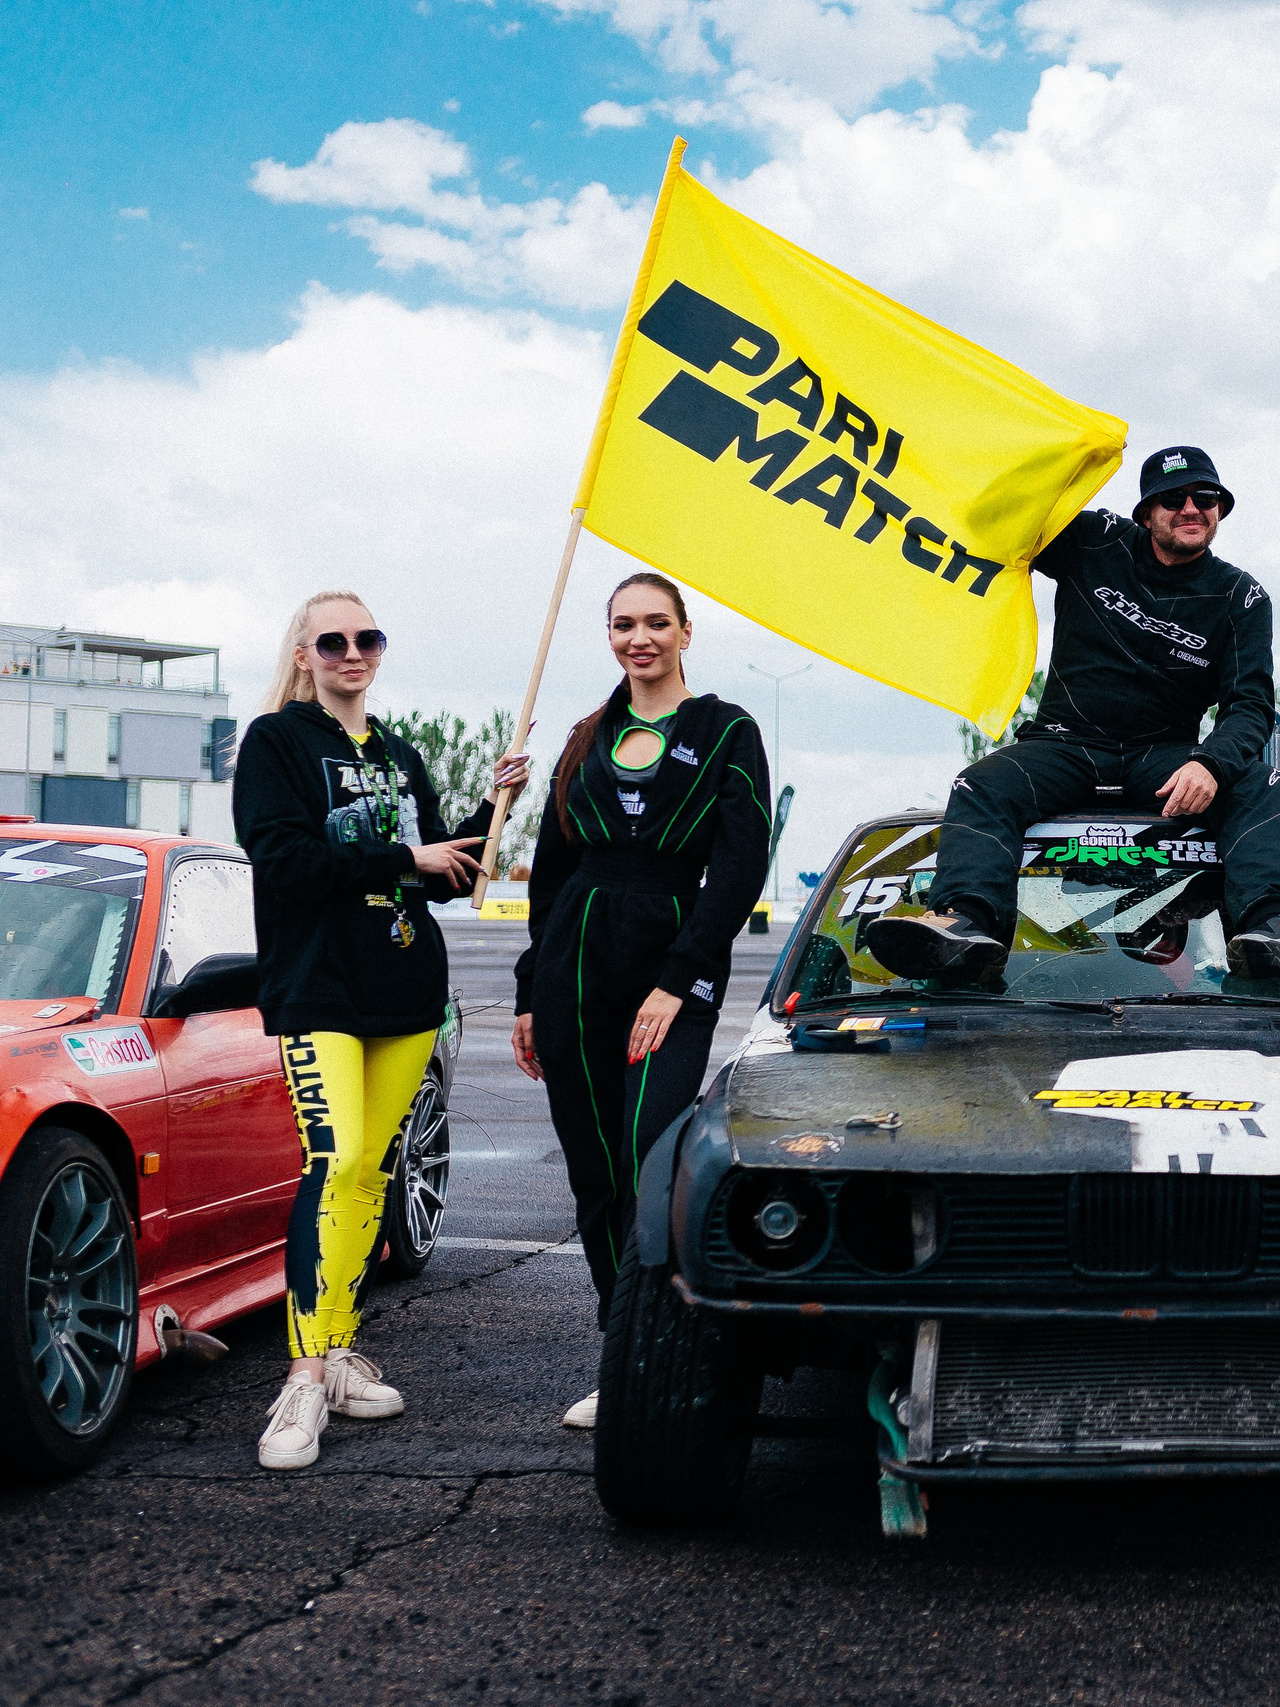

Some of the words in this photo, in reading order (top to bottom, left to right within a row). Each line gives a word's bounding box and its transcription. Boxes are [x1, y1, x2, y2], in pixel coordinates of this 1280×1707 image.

[637, 279, 905, 479] PARI
[1162, 458, 1188, 471] GORILLA
[639, 369, 1007, 598] MATCH
[670, 748, 698, 766] GORILLA
[1078, 836, 1136, 847] GORILLA
[1157, 839, 1217, 852] STRE
[837, 875, 910, 918] 15
[88, 1032, 150, 1068] Castrol
[1034, 1090, 1183, 1100] PARI
[1053, 1098, 1254, 1111] MATCH
